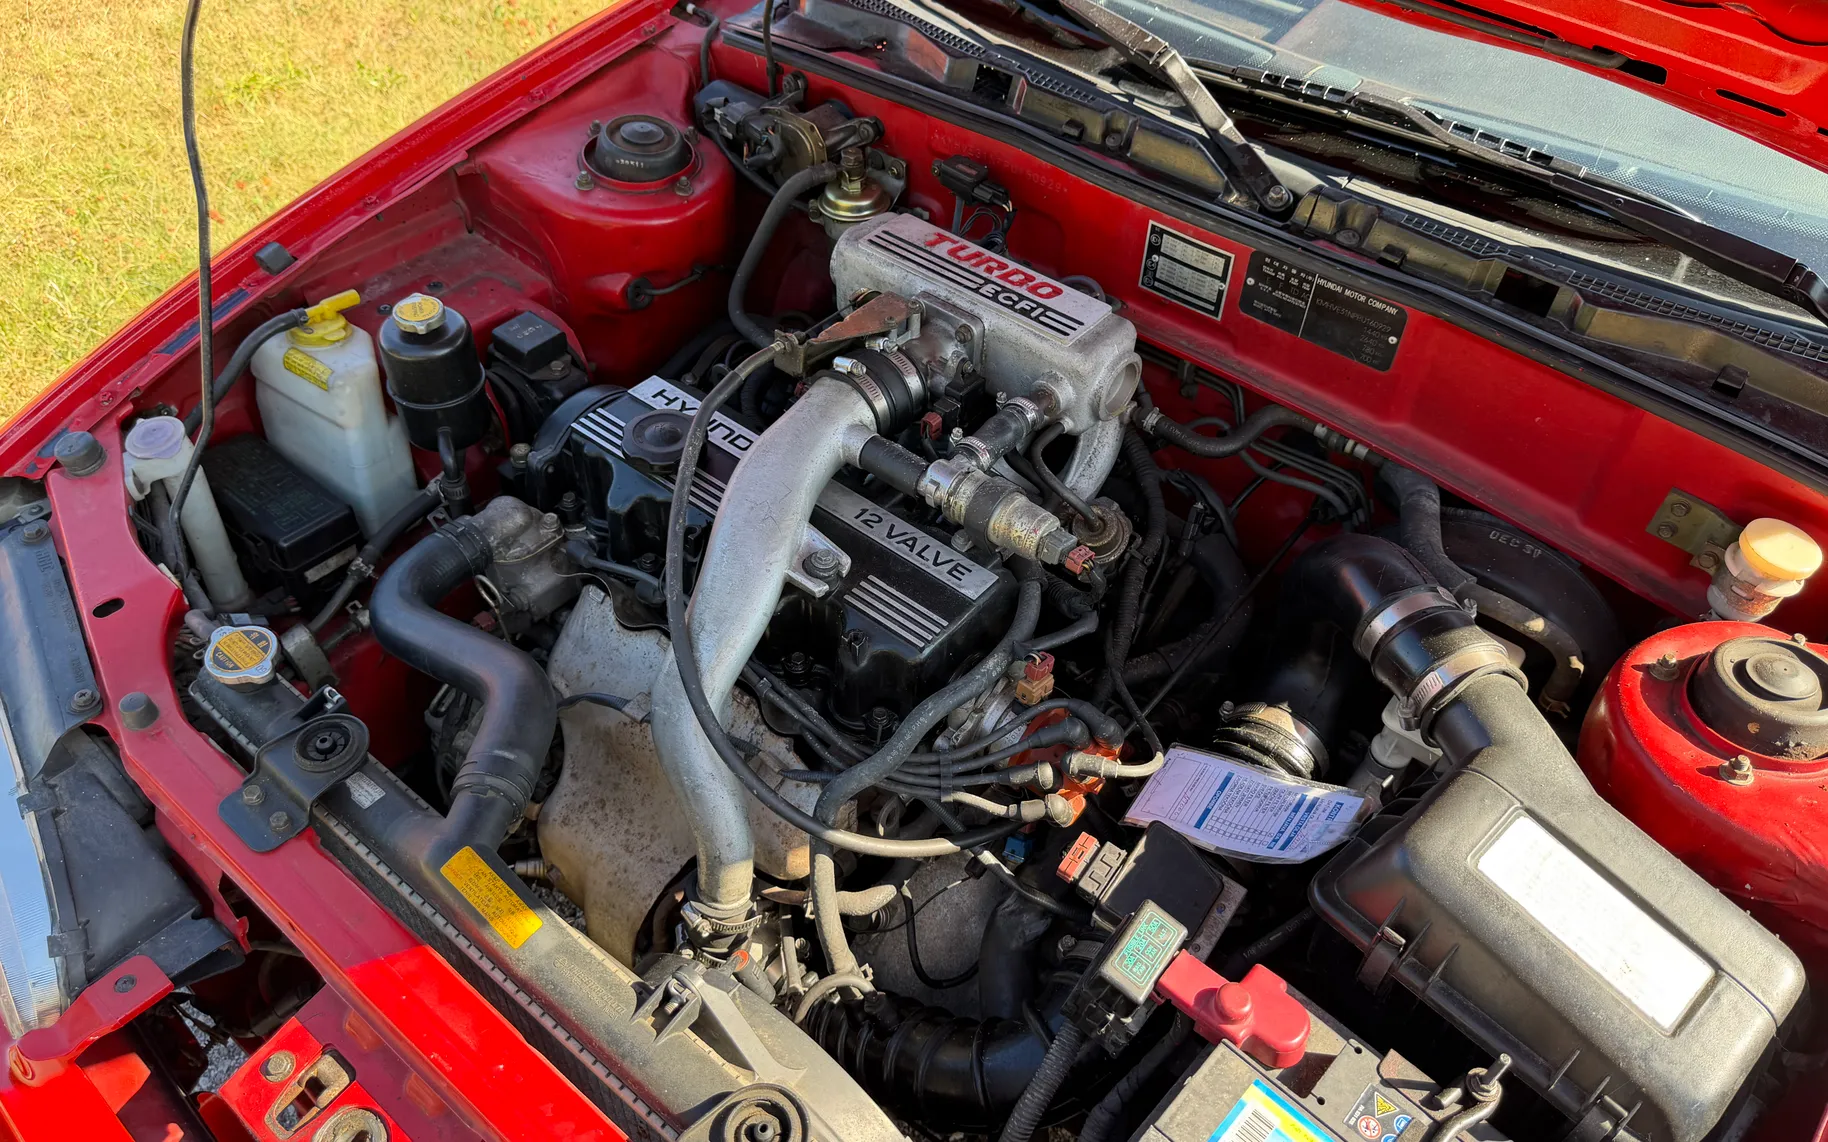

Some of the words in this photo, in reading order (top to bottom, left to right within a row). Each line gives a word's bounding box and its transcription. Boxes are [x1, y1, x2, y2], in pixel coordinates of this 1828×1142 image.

[924, 232, 1064, 299] TURBO
[978, 283, 1045, 318] ECFI
[1316, 277, 1342, 293] HYUNDAI
[1343, 288, 1366, 303] MOTOR
[1367, 297, 1398, 315] COMPANY
[854, 508, 883, 529] 12
[885, 523, 972, 582] VALVE
[1297, 811, 1309, 826] VRSTA
[1122, 934, 1140, 956] FUSIBLE
[1137, 922, 1148, 935] LINK
